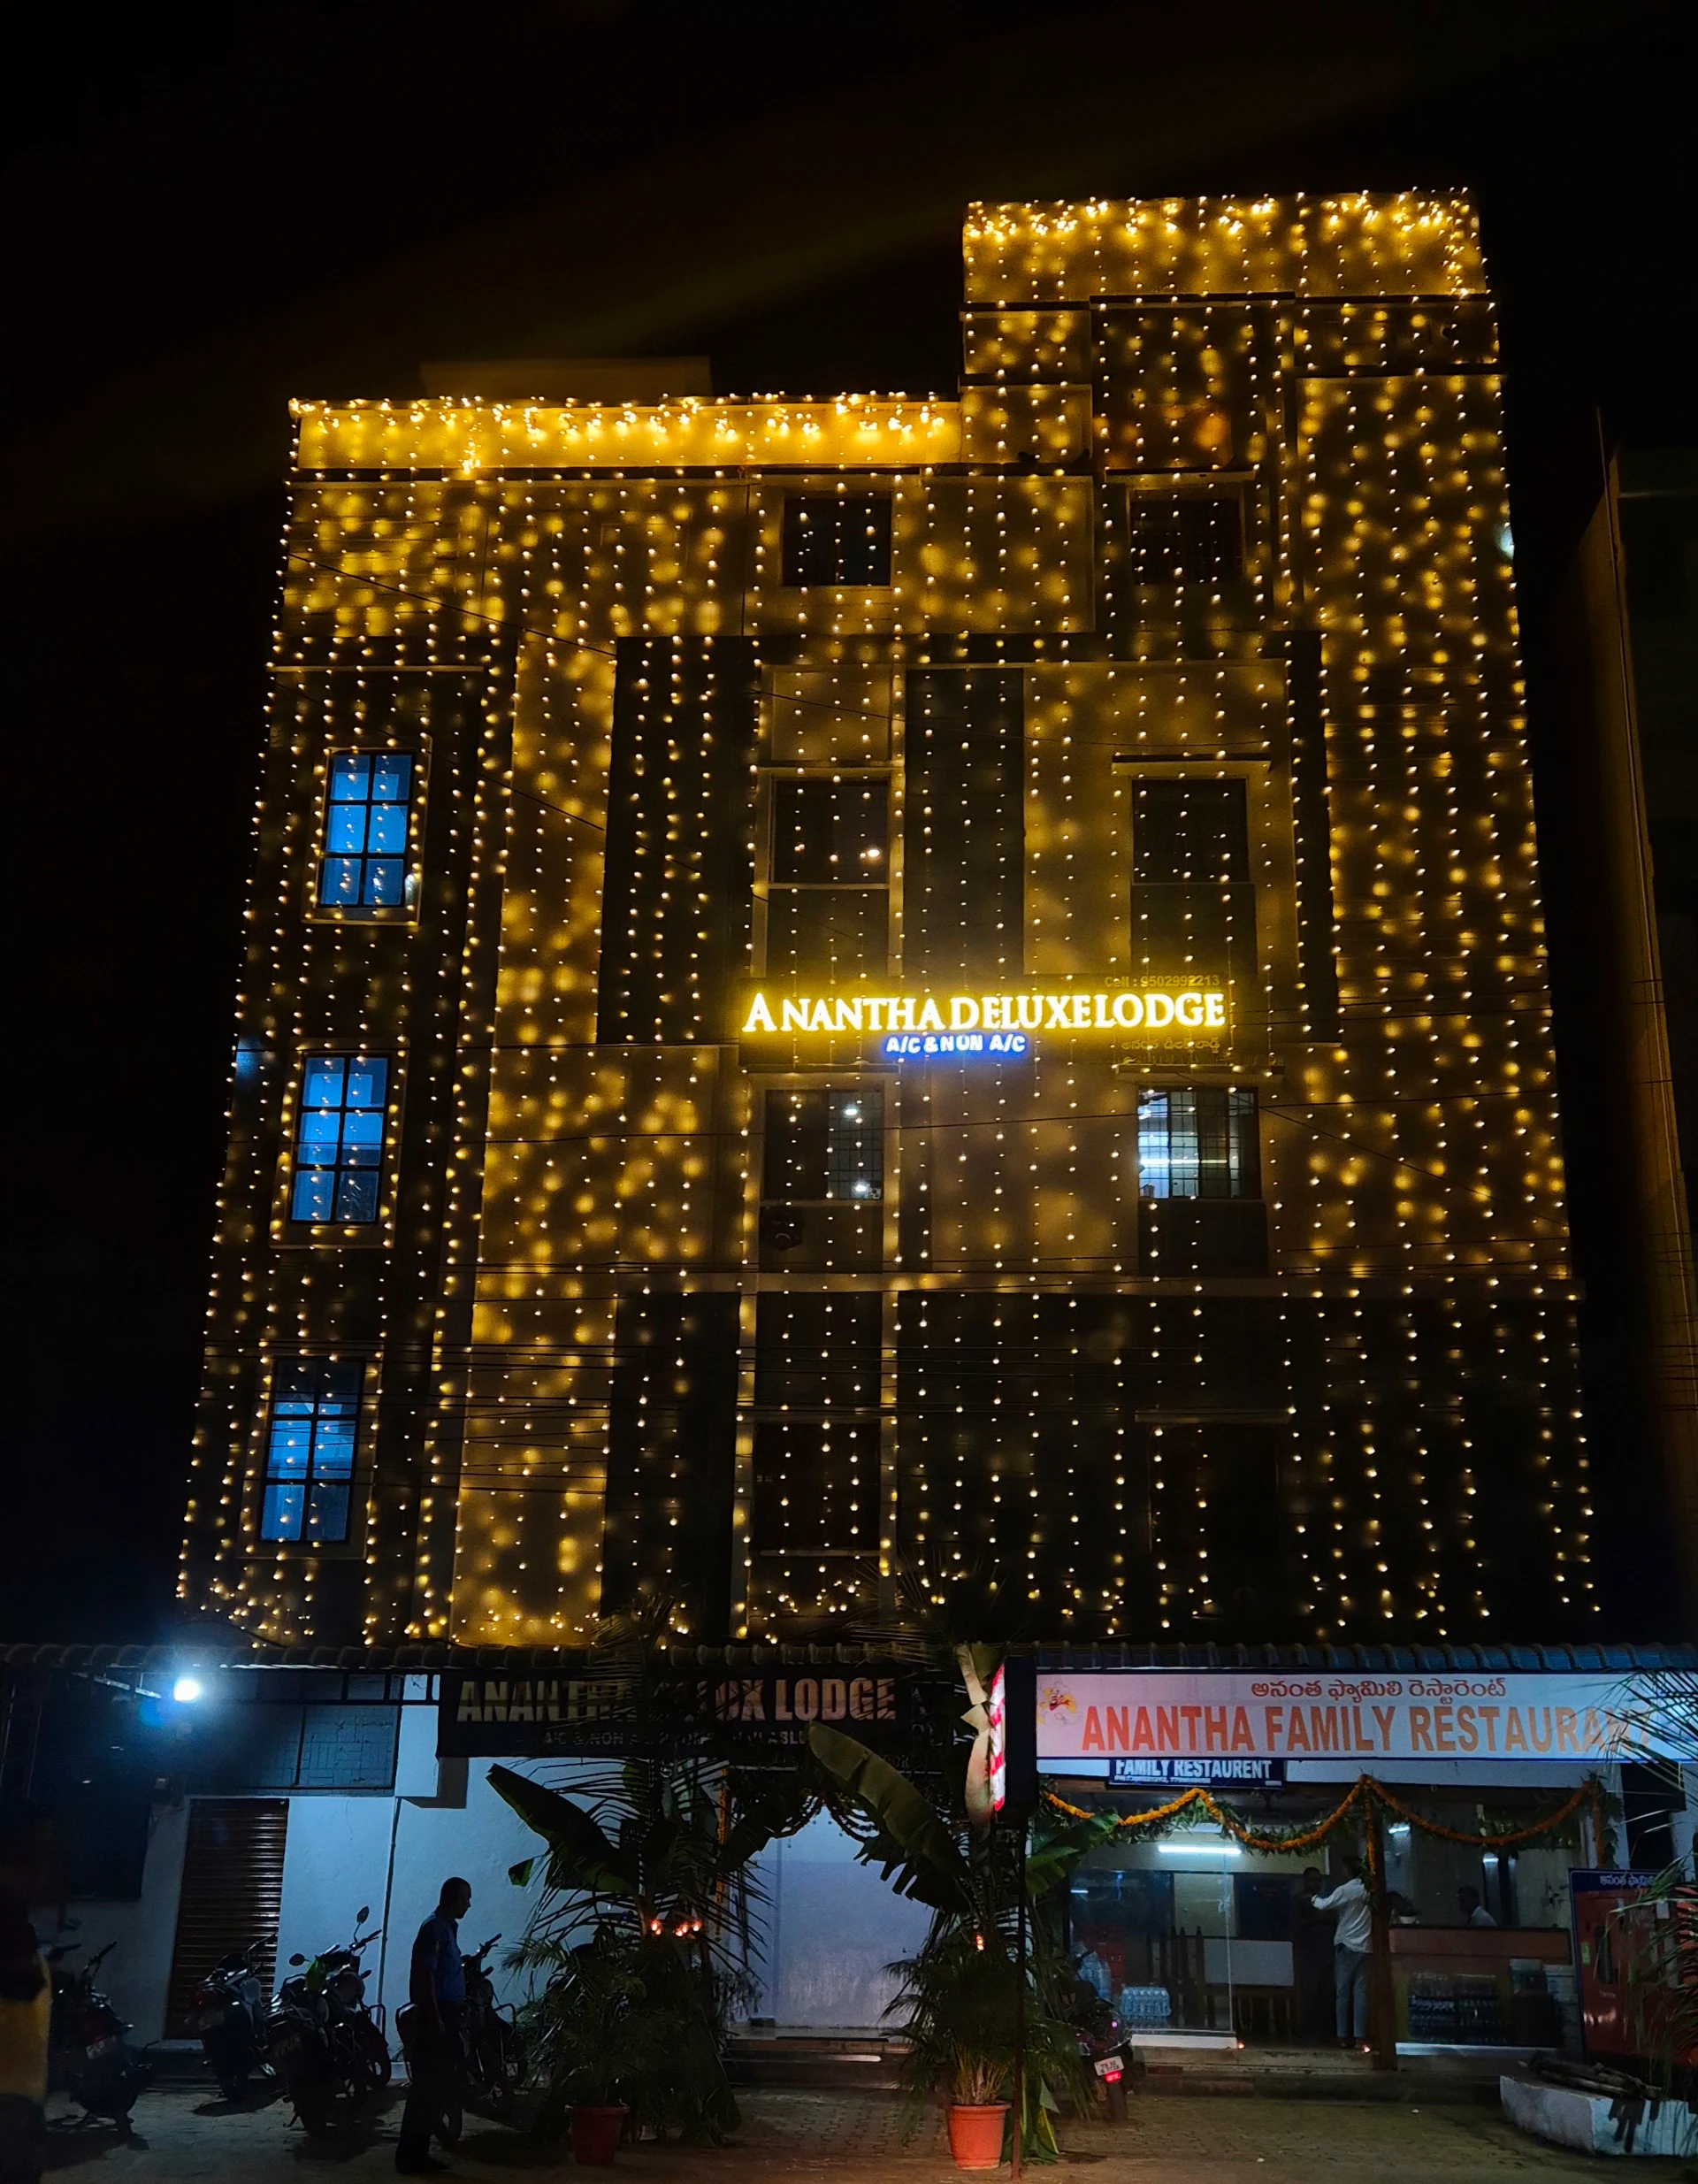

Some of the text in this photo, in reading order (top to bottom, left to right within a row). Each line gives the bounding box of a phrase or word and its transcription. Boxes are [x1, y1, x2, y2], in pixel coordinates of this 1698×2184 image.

[886, 1036, 921, 1053] A/C
[989, 1033, 1026, 1052] A/C
[774, 1677, 896, 1721] LODGE
[1251, 1681, 1320, 1697] అనంత
[1082, 1705, 1255, 1751] ANANTHA
[1264, 1705, 1396, 1751] FAMILY
[1115, 1759, 1272, 1778] FAMILY RESTAURENT
